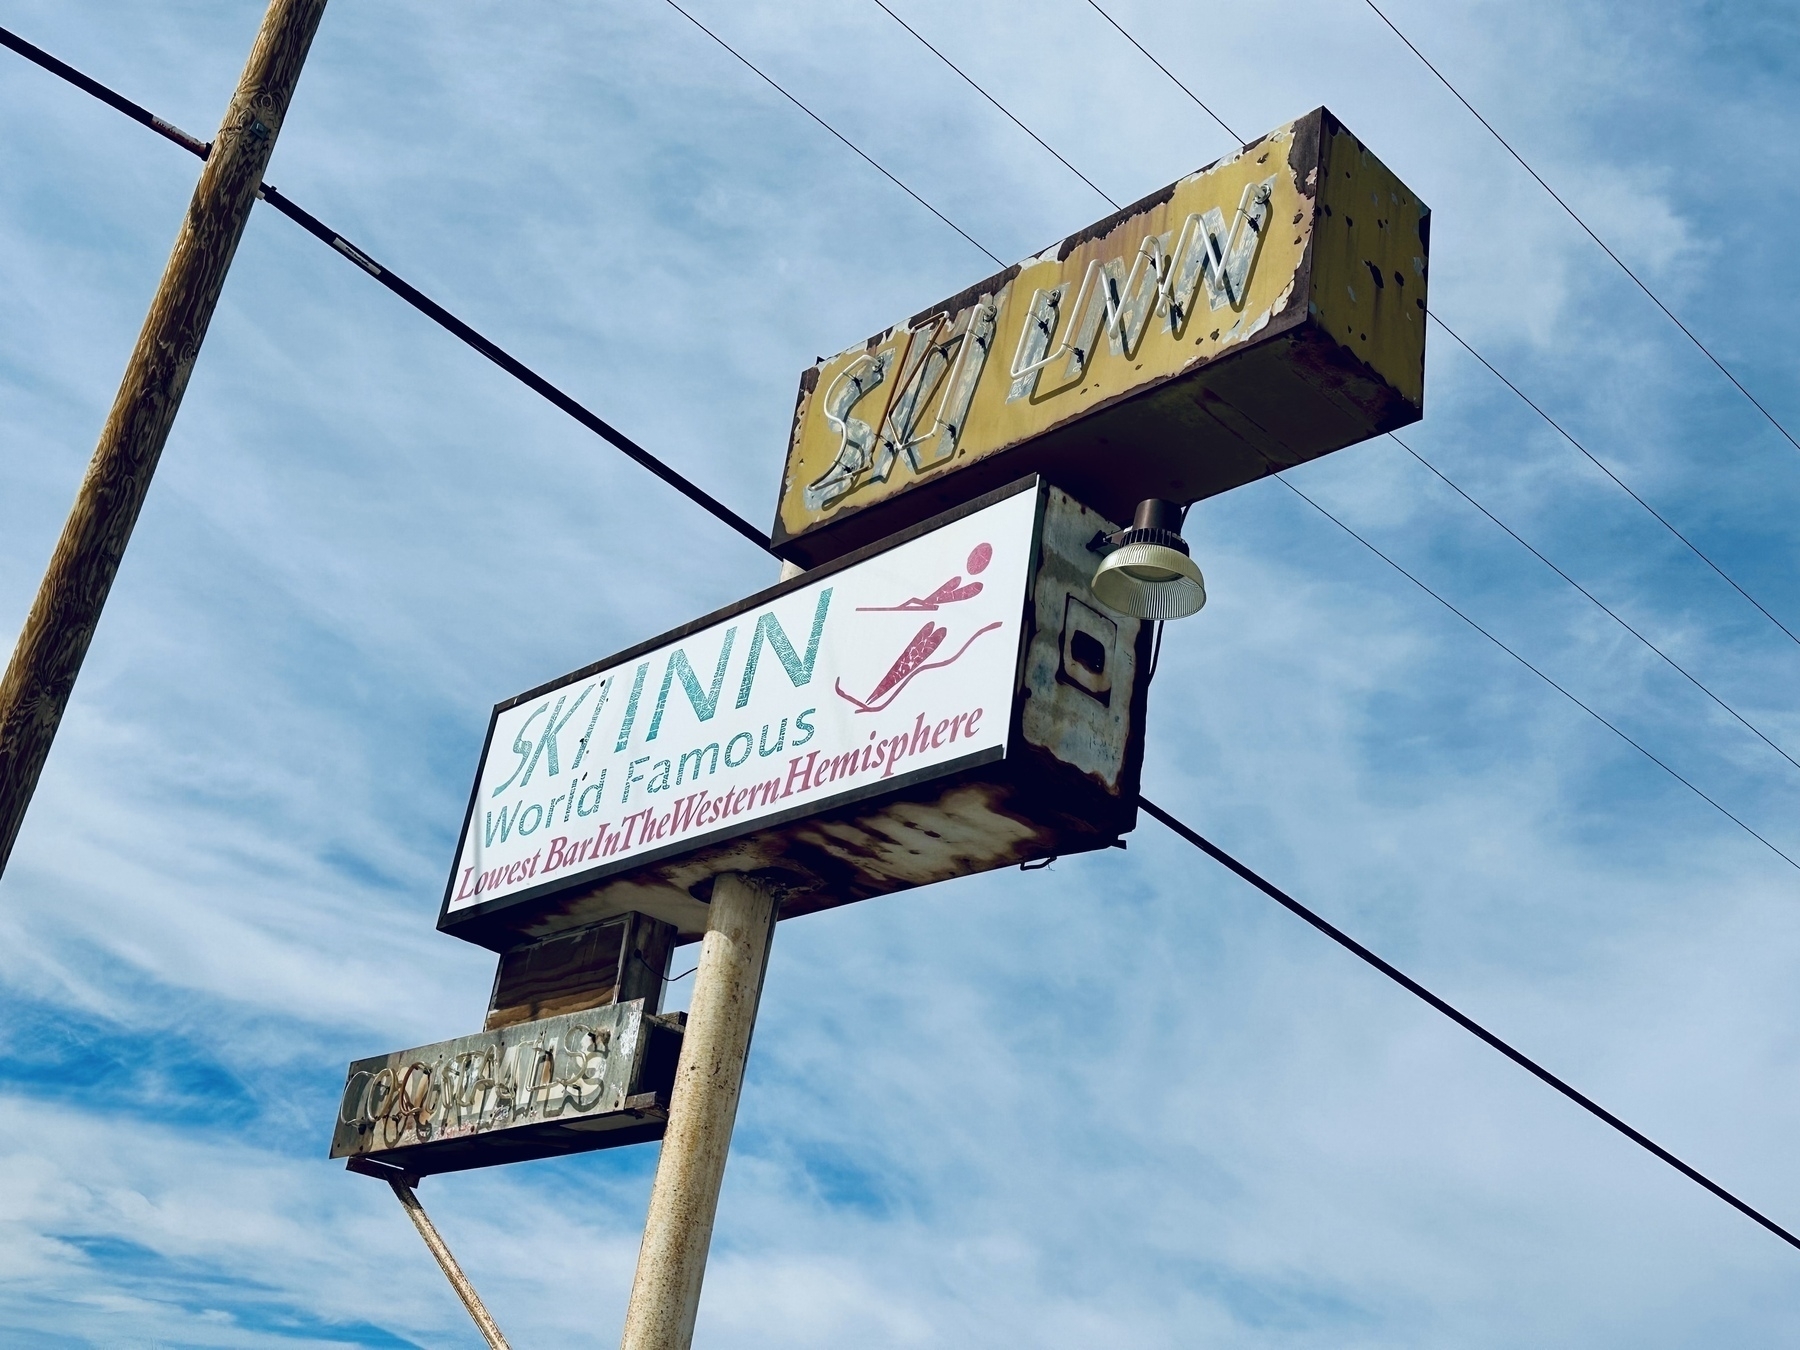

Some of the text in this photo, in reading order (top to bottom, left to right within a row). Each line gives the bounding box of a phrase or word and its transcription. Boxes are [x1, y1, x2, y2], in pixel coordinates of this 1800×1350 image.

[804, 173, 1278, 512] SKI INN
[485, 708, 816, 848] World Famous
[492, 587, 834, 798] SKI INN
[454, 847, 542, 902] Lowest
